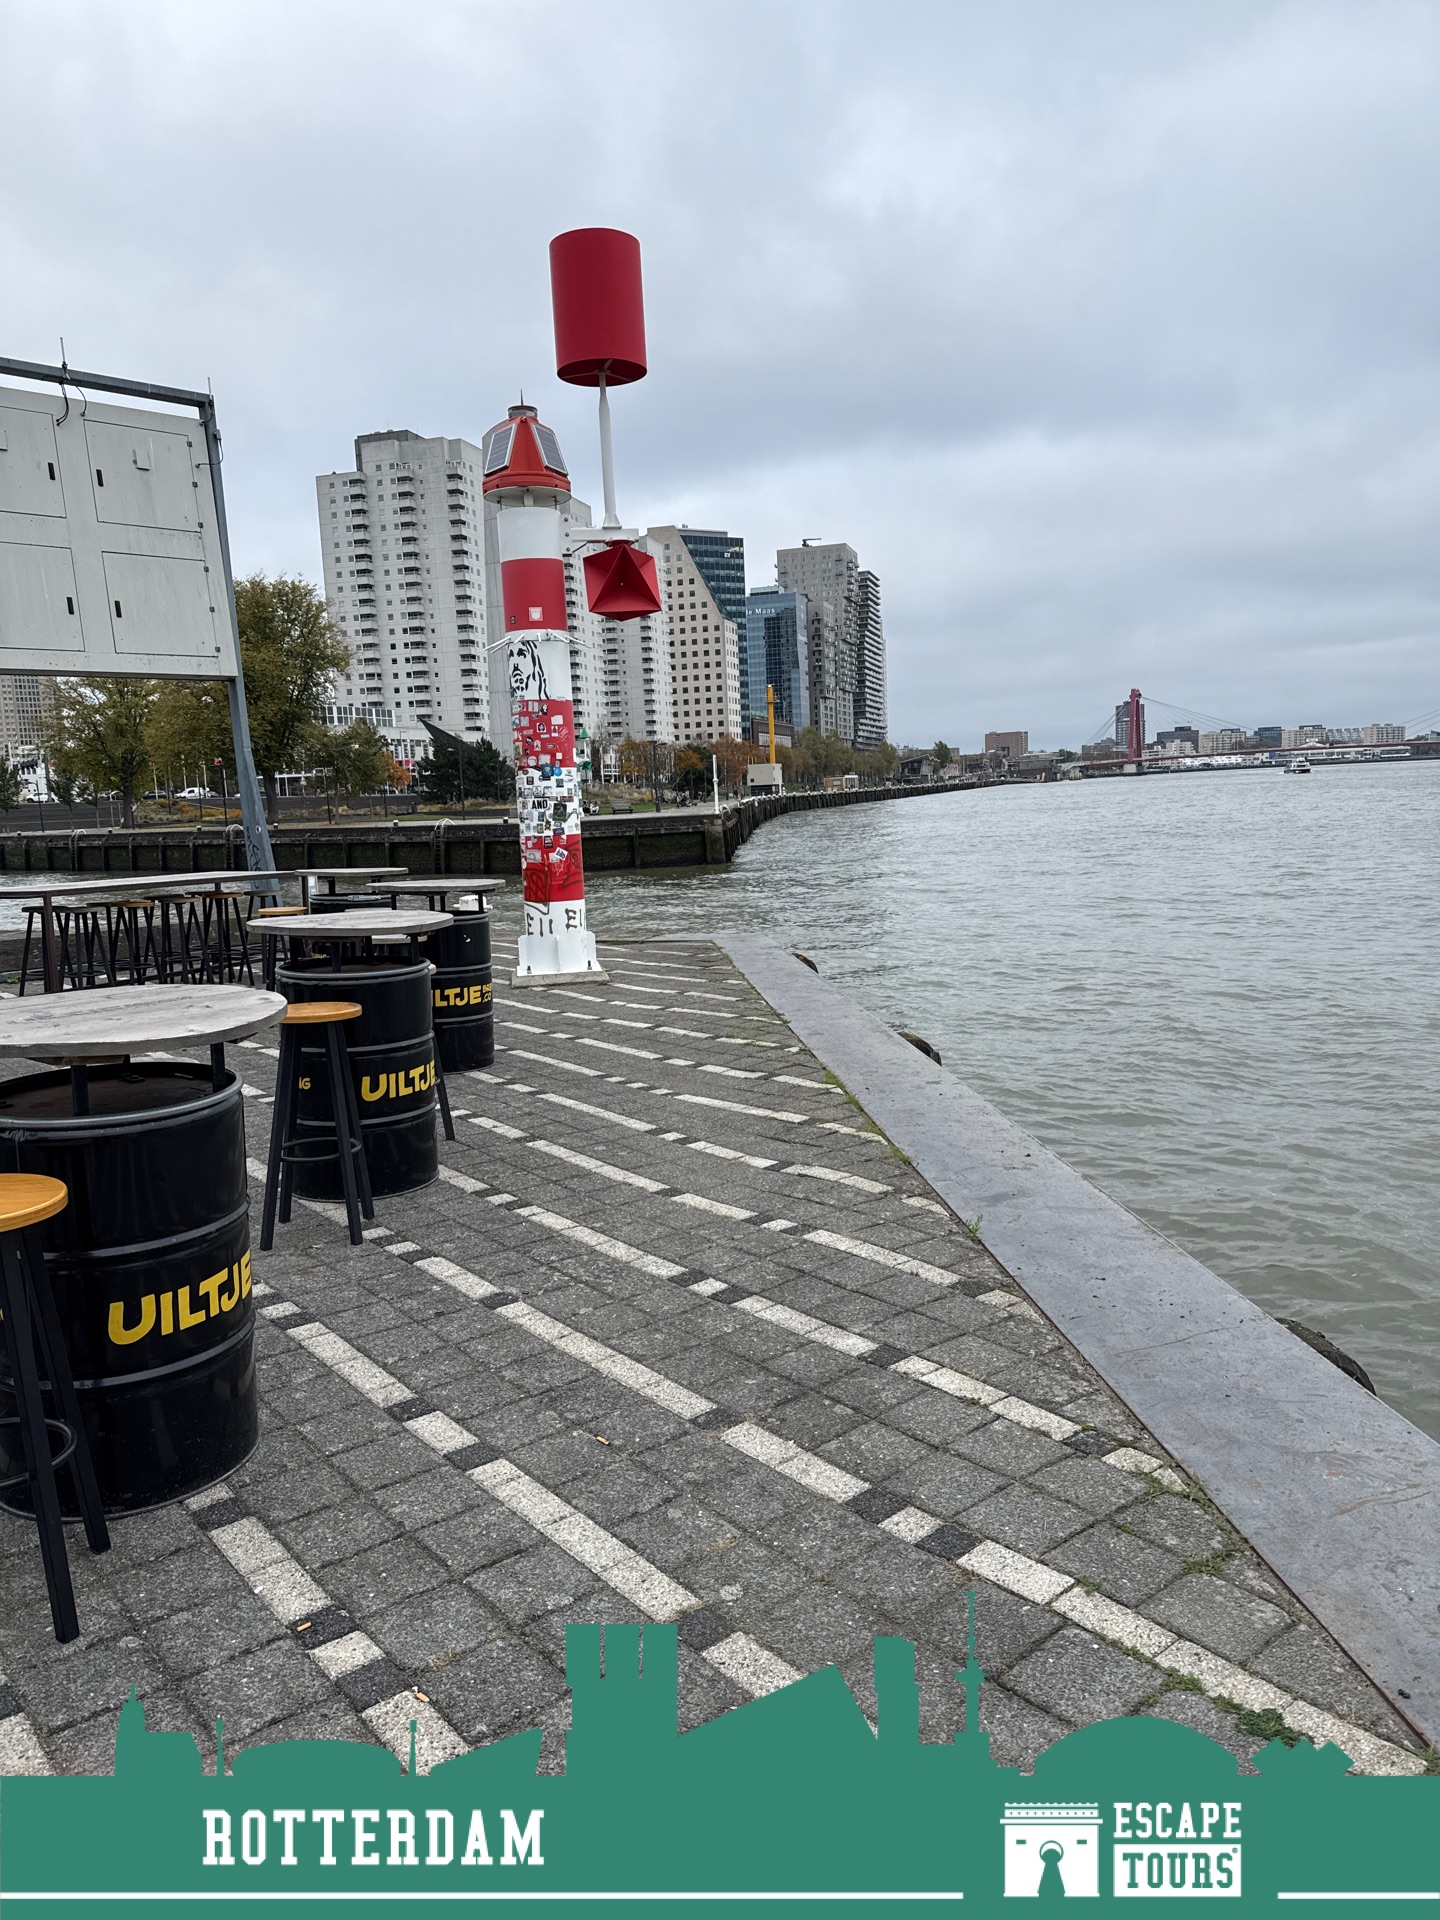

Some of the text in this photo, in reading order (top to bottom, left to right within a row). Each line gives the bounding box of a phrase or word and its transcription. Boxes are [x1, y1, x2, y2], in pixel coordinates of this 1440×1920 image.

[531, 799, 549, 810] AND
[361, 1059, 436, 1102] UILTJE
[108, 1247, 252, 1345] UILTJE
